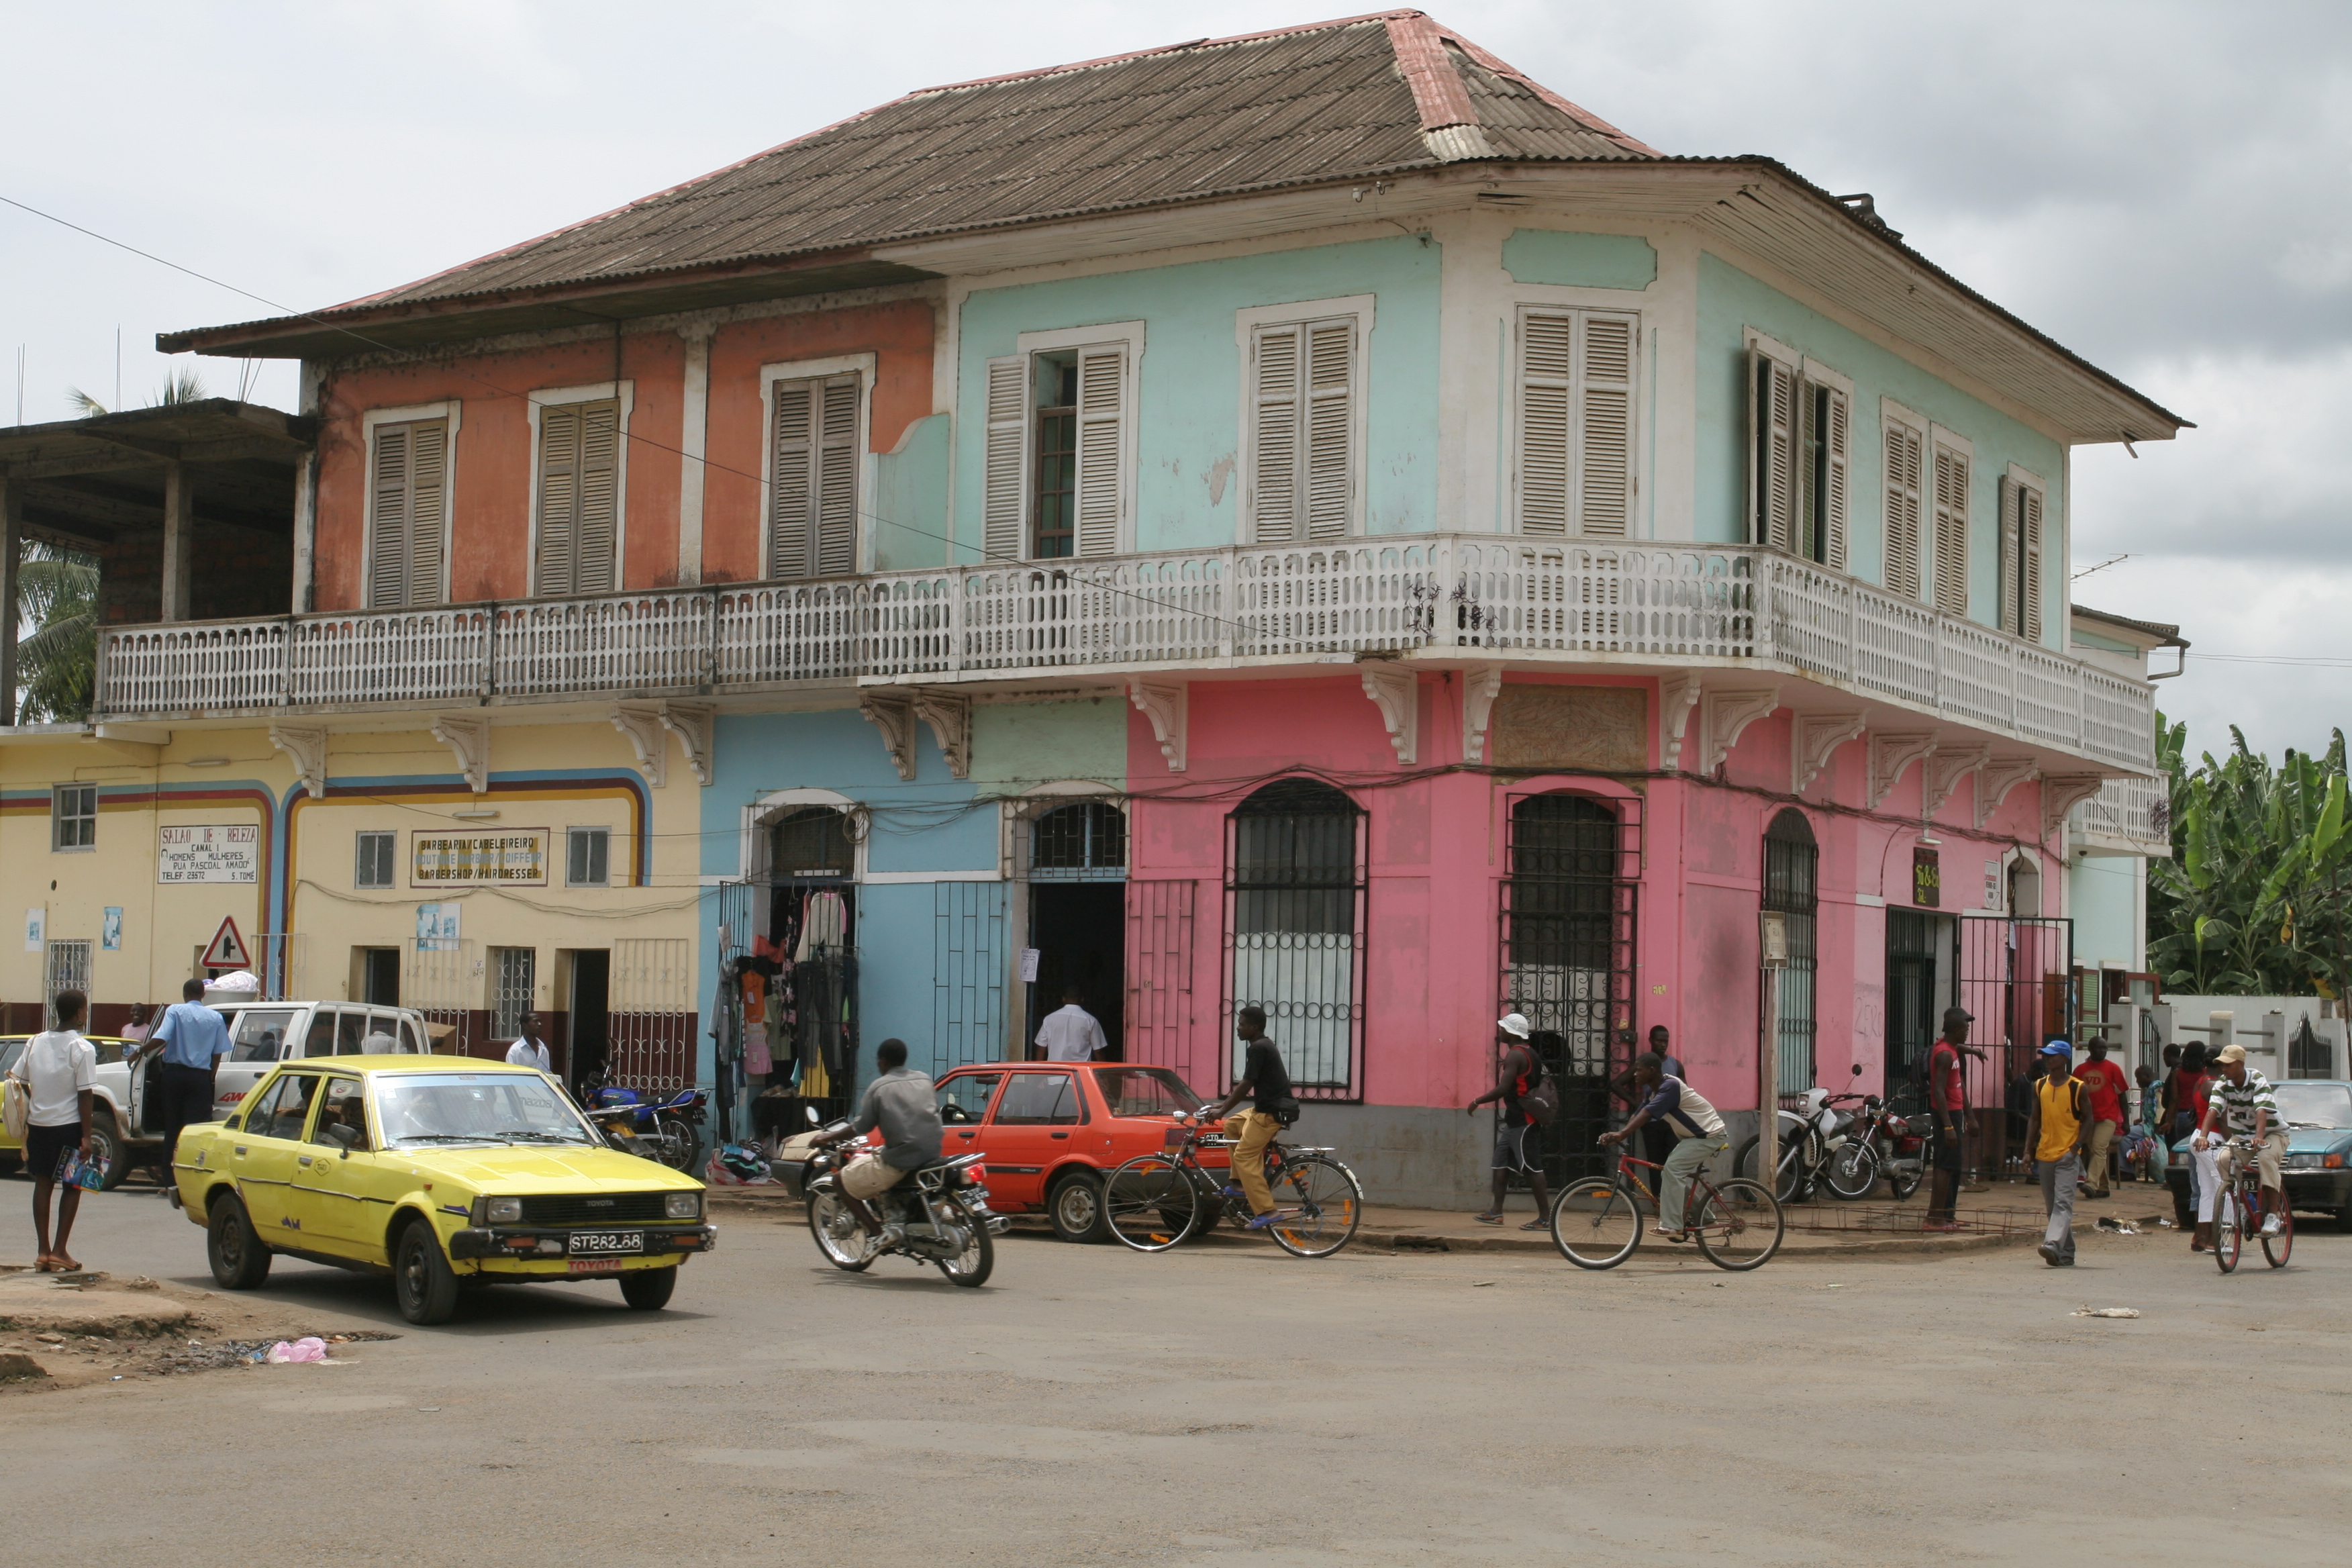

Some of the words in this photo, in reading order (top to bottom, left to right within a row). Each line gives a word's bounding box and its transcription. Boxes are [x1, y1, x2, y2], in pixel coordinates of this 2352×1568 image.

[203, 828, 213, 842] DE
[227, 828, 256, 842] BELEZA
[191, 844, 212, 852] CANAL
[421, 838, 534, 850] BARBEARIA/CABELEIREIRO
[169, 853, 195, 861] HOMENS
[415, 854, 456, 865] BOUTIQUE
[458, 852, 542, 864] BARBIER/COIFFEUR
[191, 861, 221, 869] PASCOAL
[187, 871, 205, 879] 23572
[240, 870, 254, 880] TOMÉ
[419, 869, 538, 879] BARBERSHOP/HAIRDRESSER
[569, 1259, 622, 1272] TOYOTA
